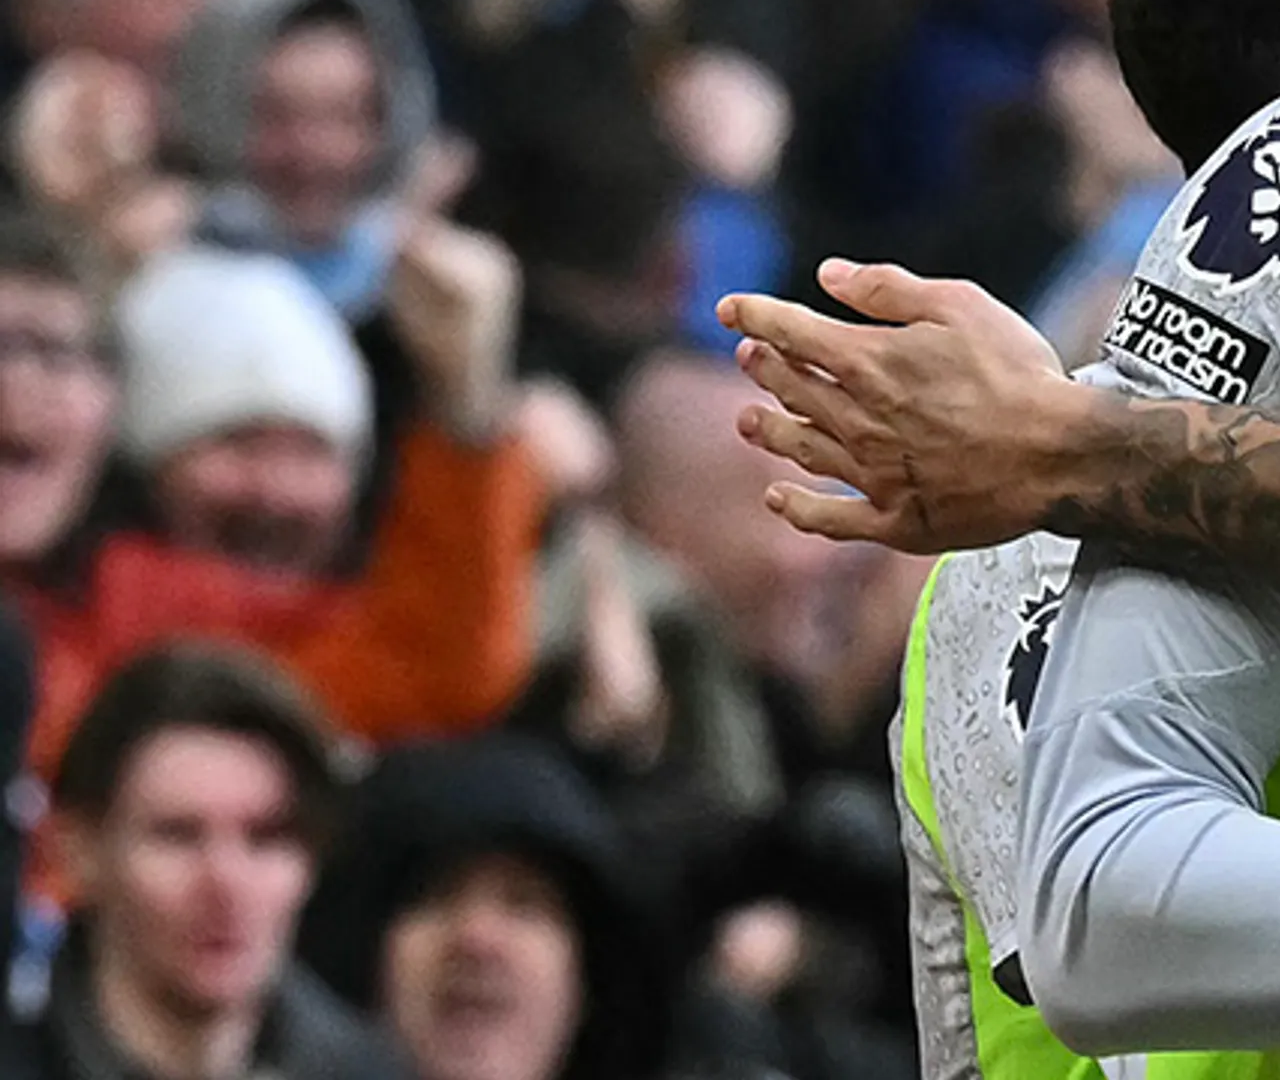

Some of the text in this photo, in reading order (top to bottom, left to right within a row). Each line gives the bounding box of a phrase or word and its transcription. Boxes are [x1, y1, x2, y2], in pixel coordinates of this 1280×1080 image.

[1121, 281, 1247, 370] No room
[1134, 329, 1249, 406] racism
